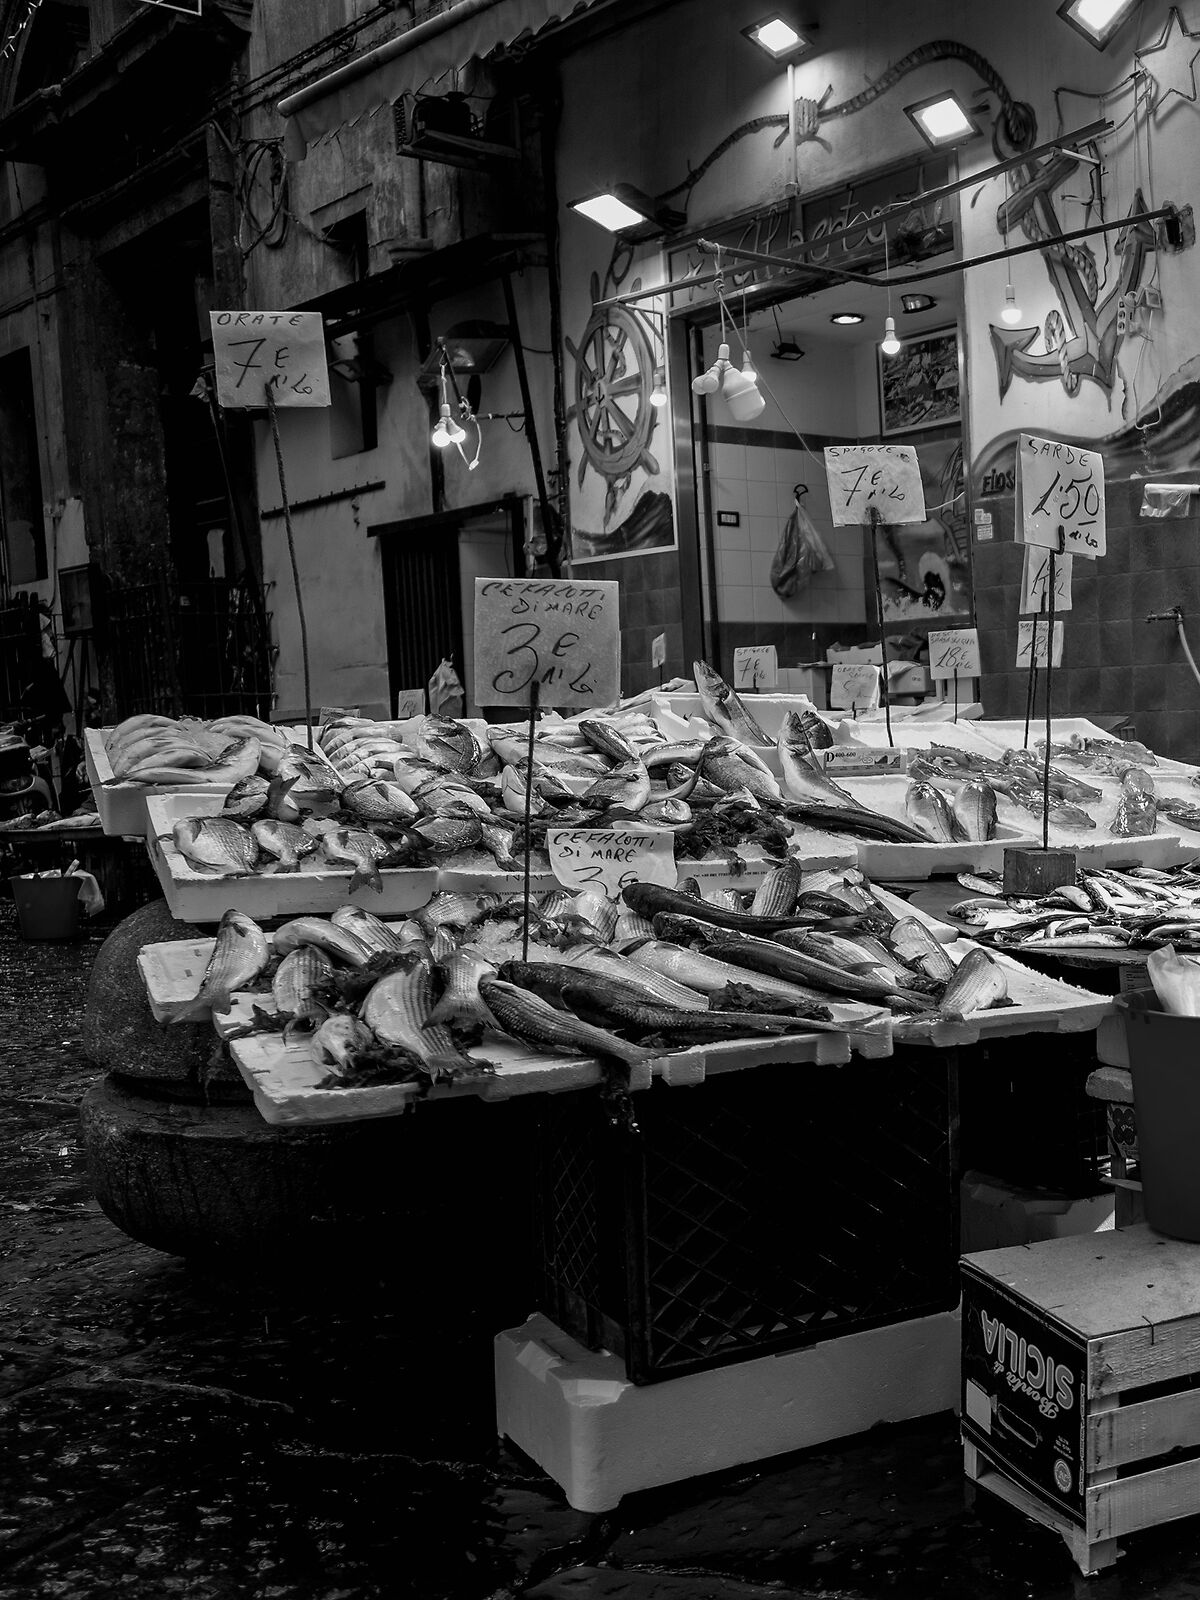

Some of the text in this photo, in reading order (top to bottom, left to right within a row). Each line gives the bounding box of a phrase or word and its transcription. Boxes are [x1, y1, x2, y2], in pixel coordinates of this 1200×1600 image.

[217, 313, 303, 326] ORATE
[228, 338, 266, 388] 7
[1029, 439, 1090, 466] SARDE
[482, 582, 605, 600] CEFALOTTI
[545, 601, 603, 619] MARE
[492, 623, 540, 694] 3
[737, 657, 752, 682] 7
[935, 646, 962, 669] 18
[553, 831, 655, 848] CEFALOTTI
[591, 847, 637, 862] MARE
[981, 1310, 1075, 1411] SICILIA
[993, 1360, 1060, 1420] Bontà di
